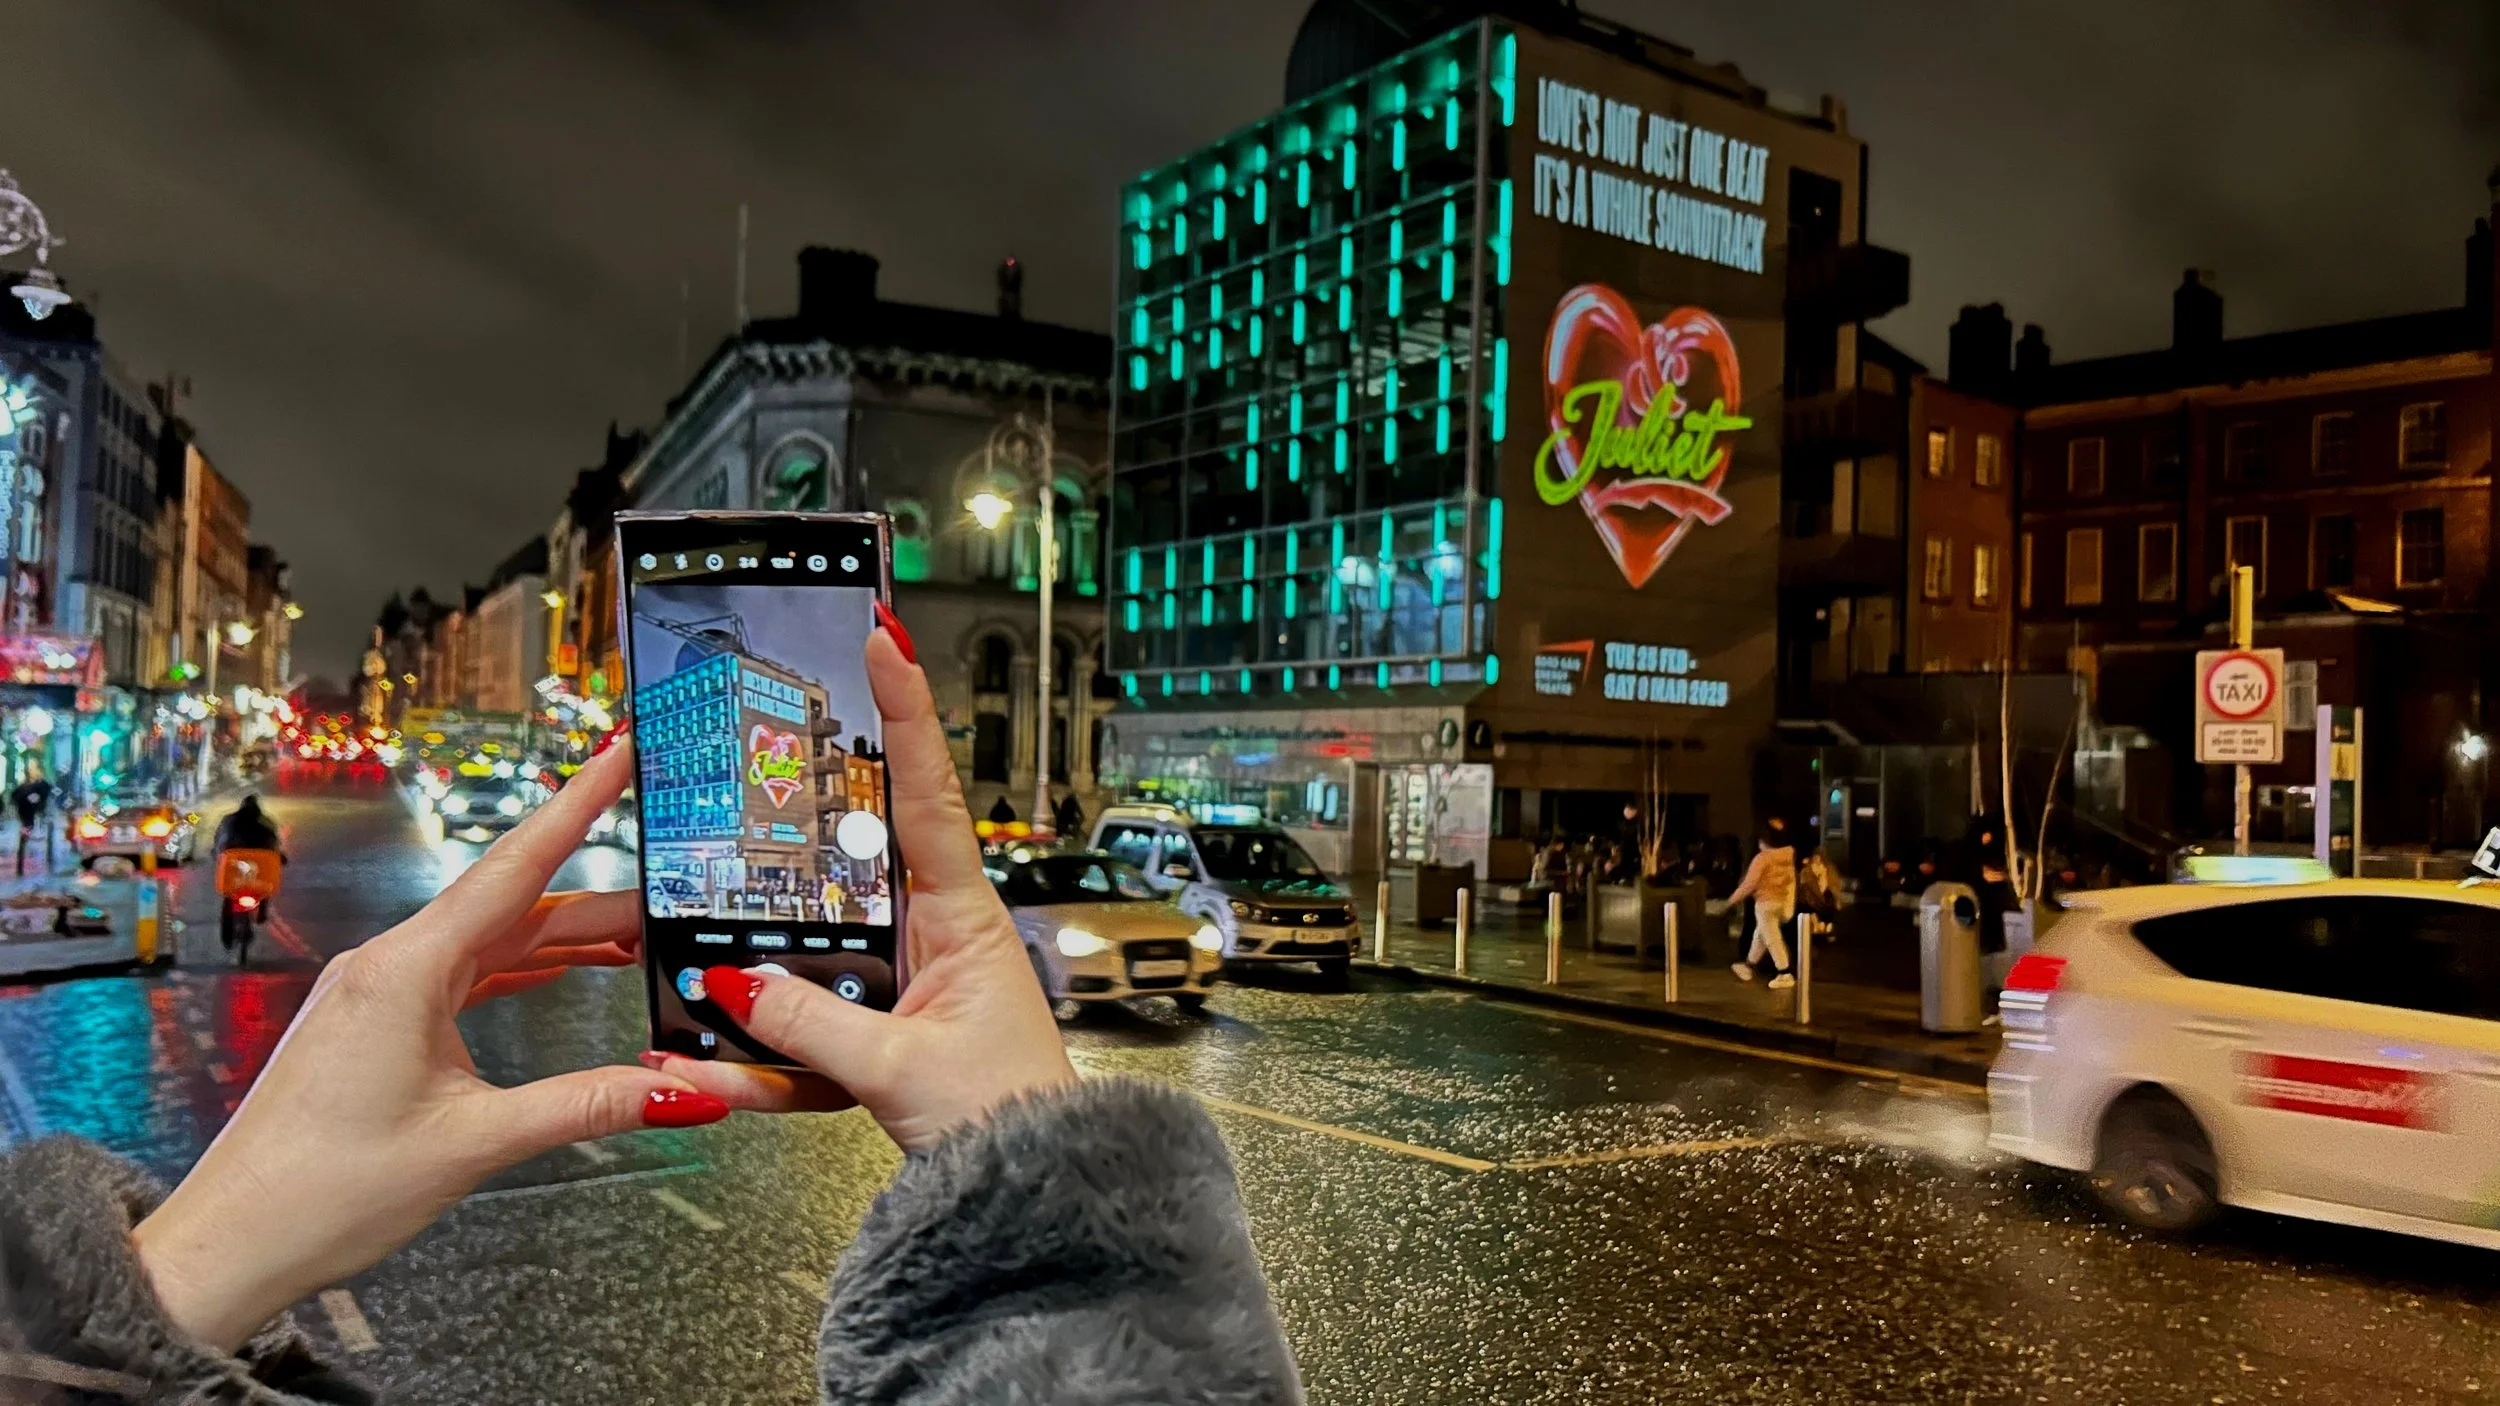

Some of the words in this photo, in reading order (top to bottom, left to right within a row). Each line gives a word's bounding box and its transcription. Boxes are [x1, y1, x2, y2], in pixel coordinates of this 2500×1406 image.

[1603, 97, 1641, 169] NOT
[1642, 113, 1688, 183] JUST
[1689, 126, 1726, 195] ONE
[1726, 138, 1769, 206] BEAT
[1534, 153, 1570, 224] IT'S
[1572, 164, 1588, 228] A
[1592, 169, 1654, 246] WHOLE
[1654, 188, 1767, 275] SOUNDTRACK
[1534, 379, 1753, 506] Juliet
[1604, 673, 1636, 700] SAT
[1605, 642, 1635, 670] TUE
[2216, 683, 2263, 702] TAXI
